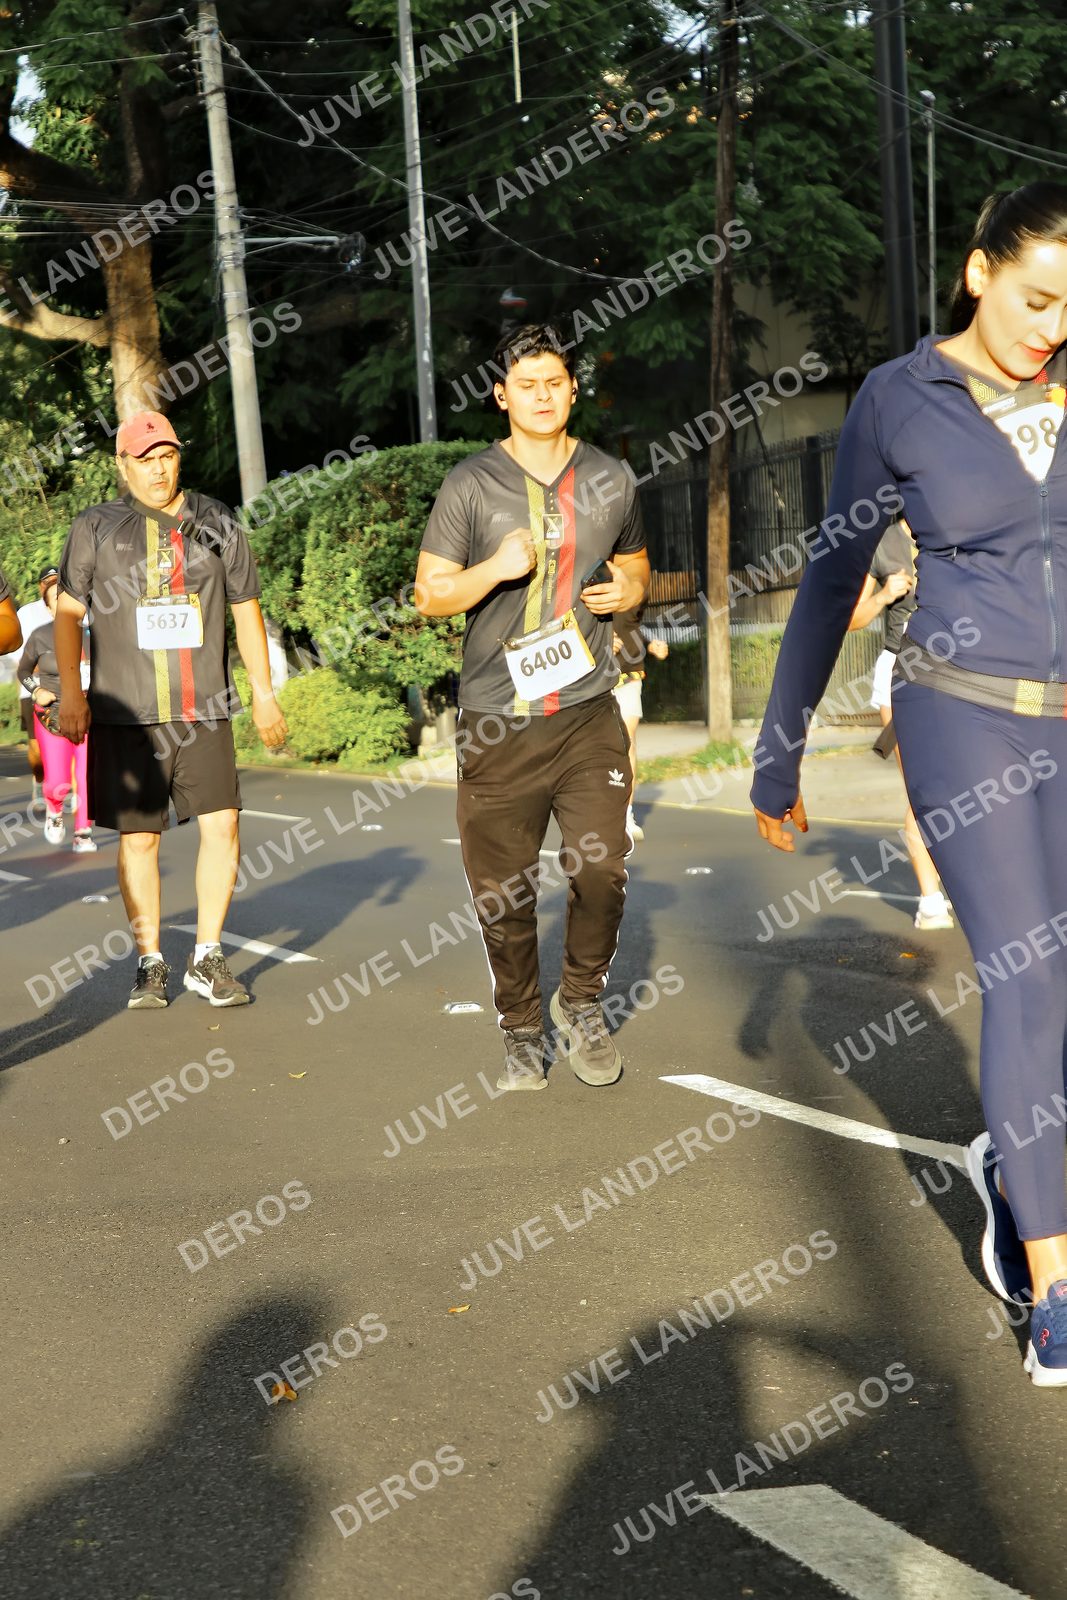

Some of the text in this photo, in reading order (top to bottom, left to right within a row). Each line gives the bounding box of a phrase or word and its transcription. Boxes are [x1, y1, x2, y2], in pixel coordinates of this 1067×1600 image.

[1017, 417, 1057, 455] 98
[146, 612, 189, 630] 5637
[520, 640, 572, 677] 6400
